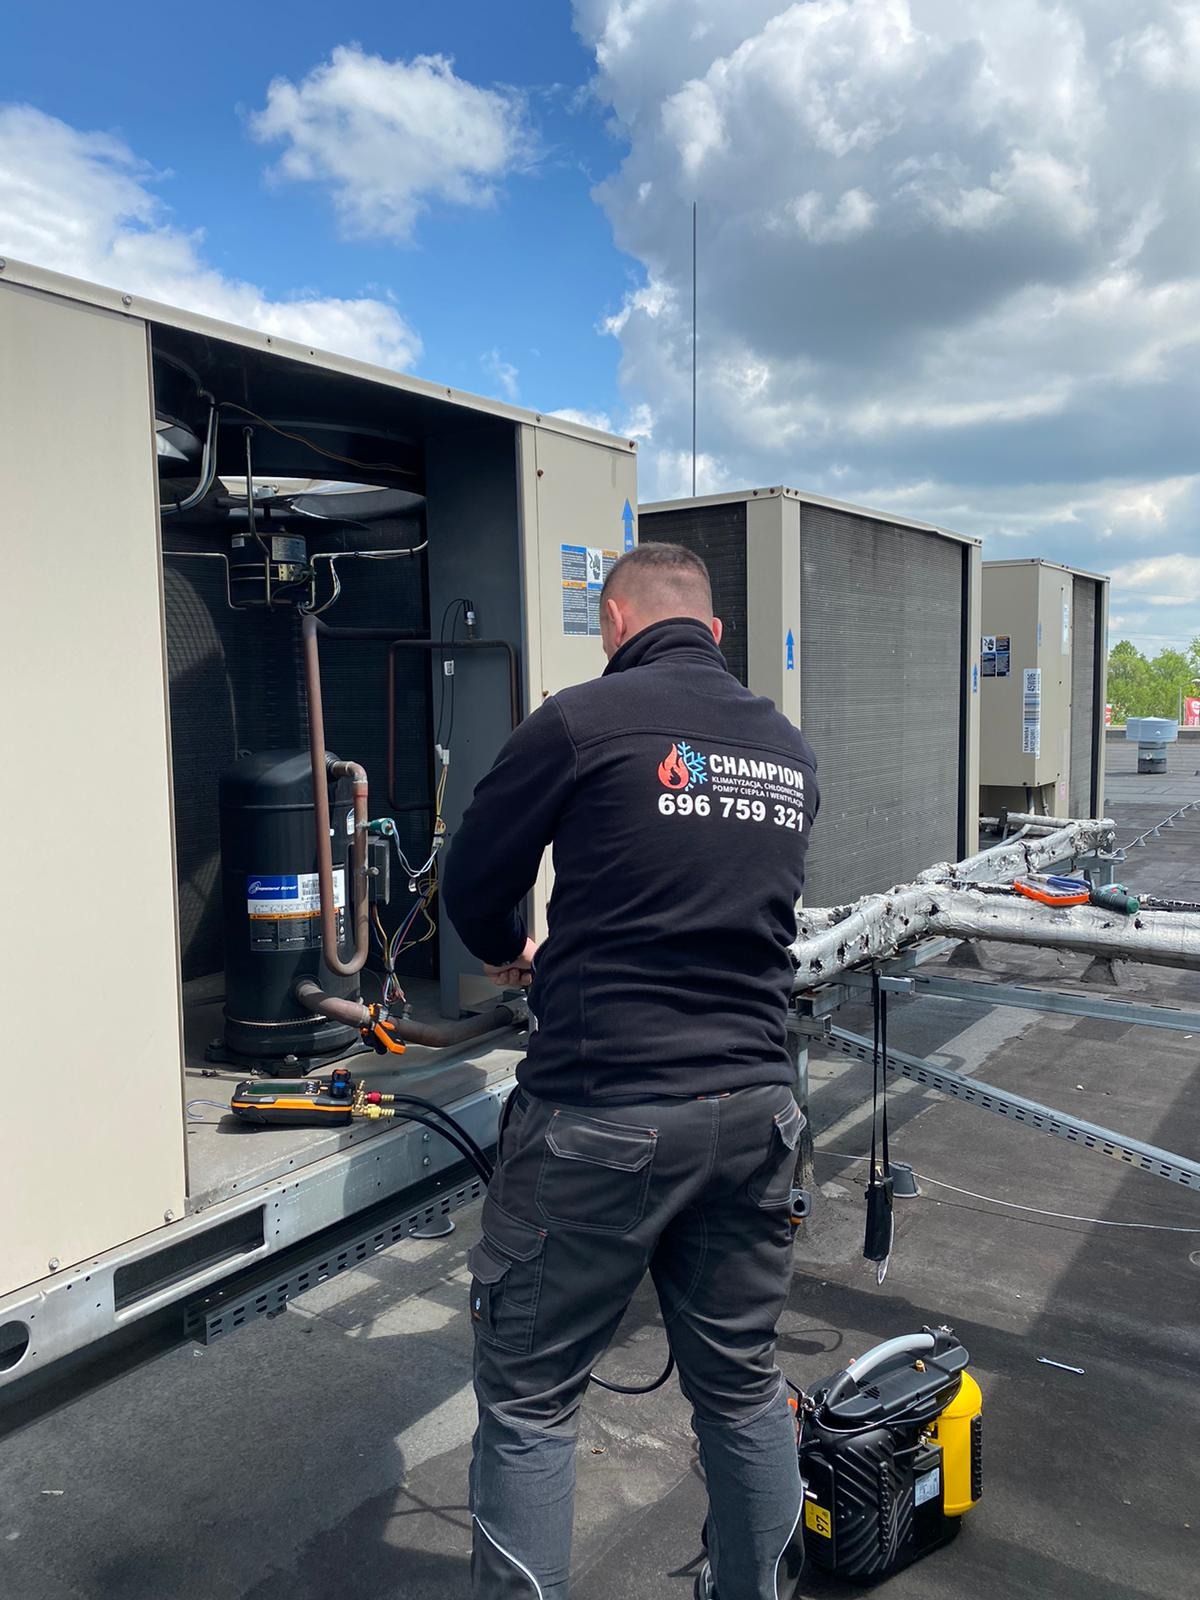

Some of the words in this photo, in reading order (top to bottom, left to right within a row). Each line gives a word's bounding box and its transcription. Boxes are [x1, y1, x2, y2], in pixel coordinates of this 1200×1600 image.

[709, 754, 804, 790] CHAMPION
[712, 785, 738, 793] POMPY
[740, 787, 765, 797] CIEPŁA
[658, 793, 711, 816] 696
[719, 796, 766, 822] 759
[773, 804, 804, 832] 321
[816, 1515, 829, 1533] 97
